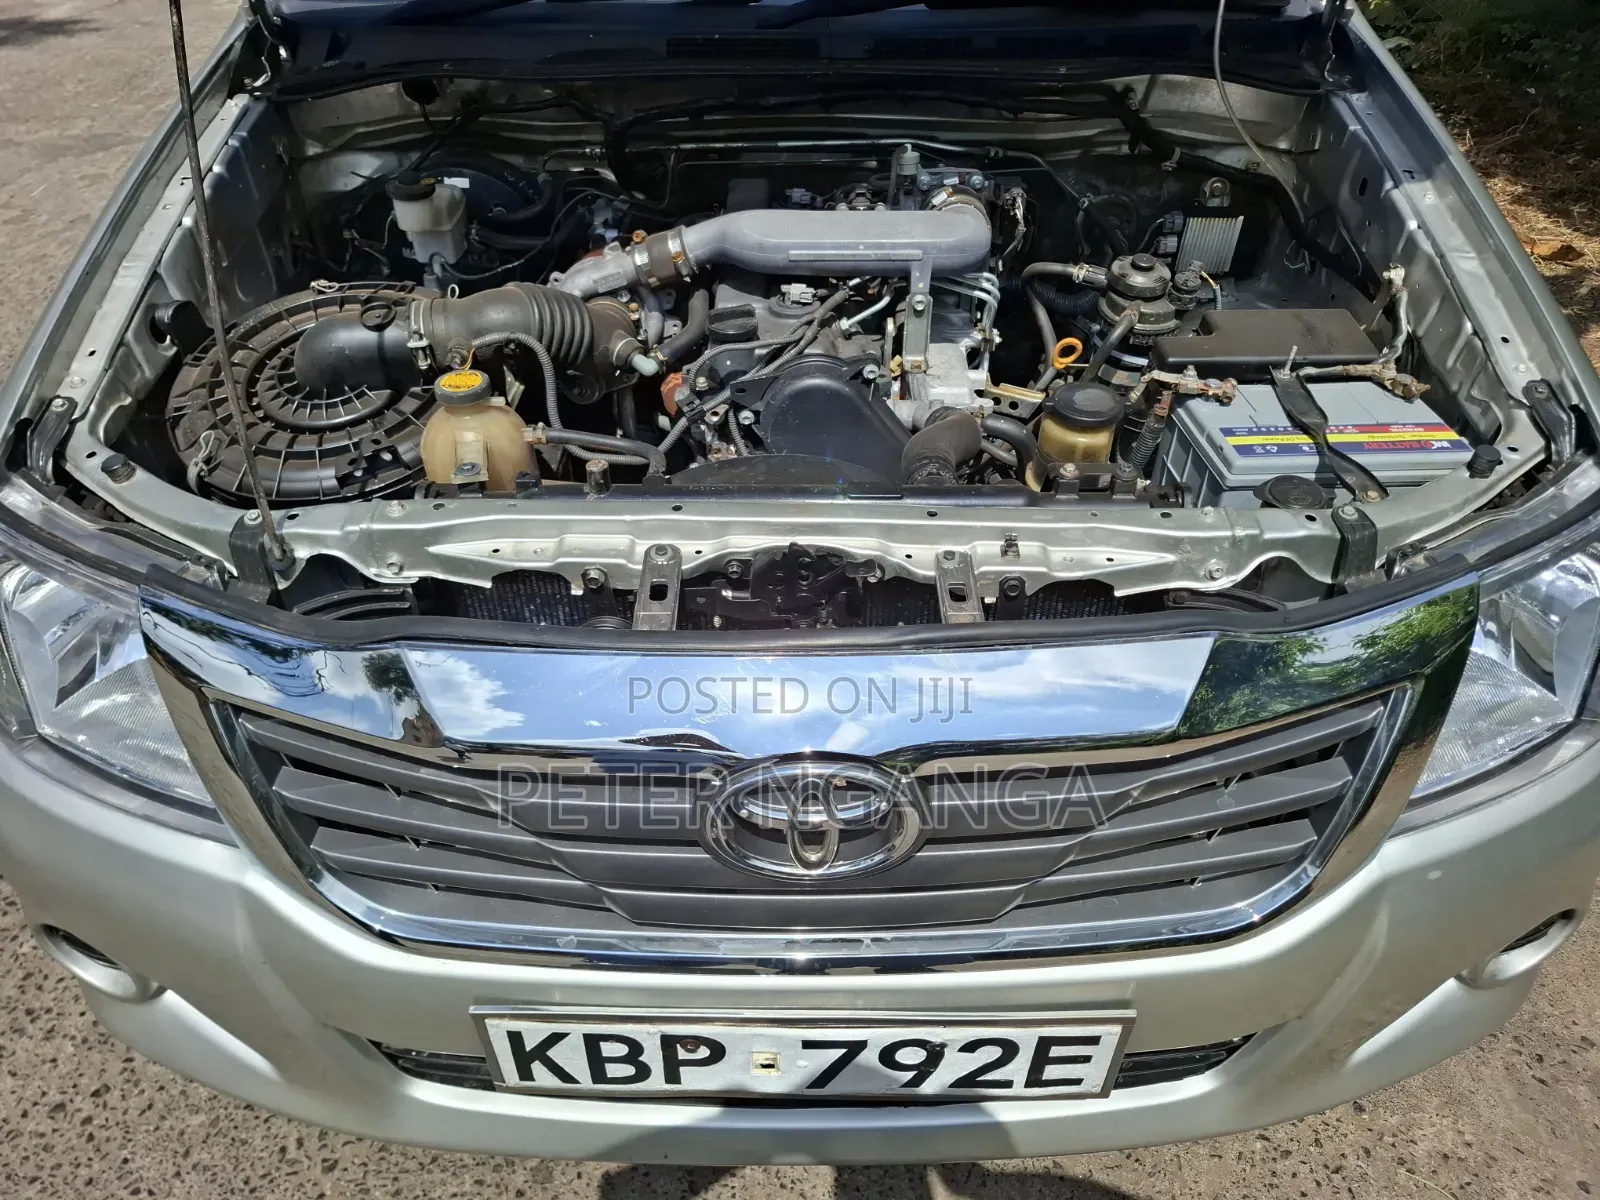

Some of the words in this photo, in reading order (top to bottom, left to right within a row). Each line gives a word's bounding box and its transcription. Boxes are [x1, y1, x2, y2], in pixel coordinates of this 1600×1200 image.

[1363, 441, 1421, 450] BATTERY
[506, 1030, 727, 1086] KBP
[799, 1034, 1103, 1091] 792E
